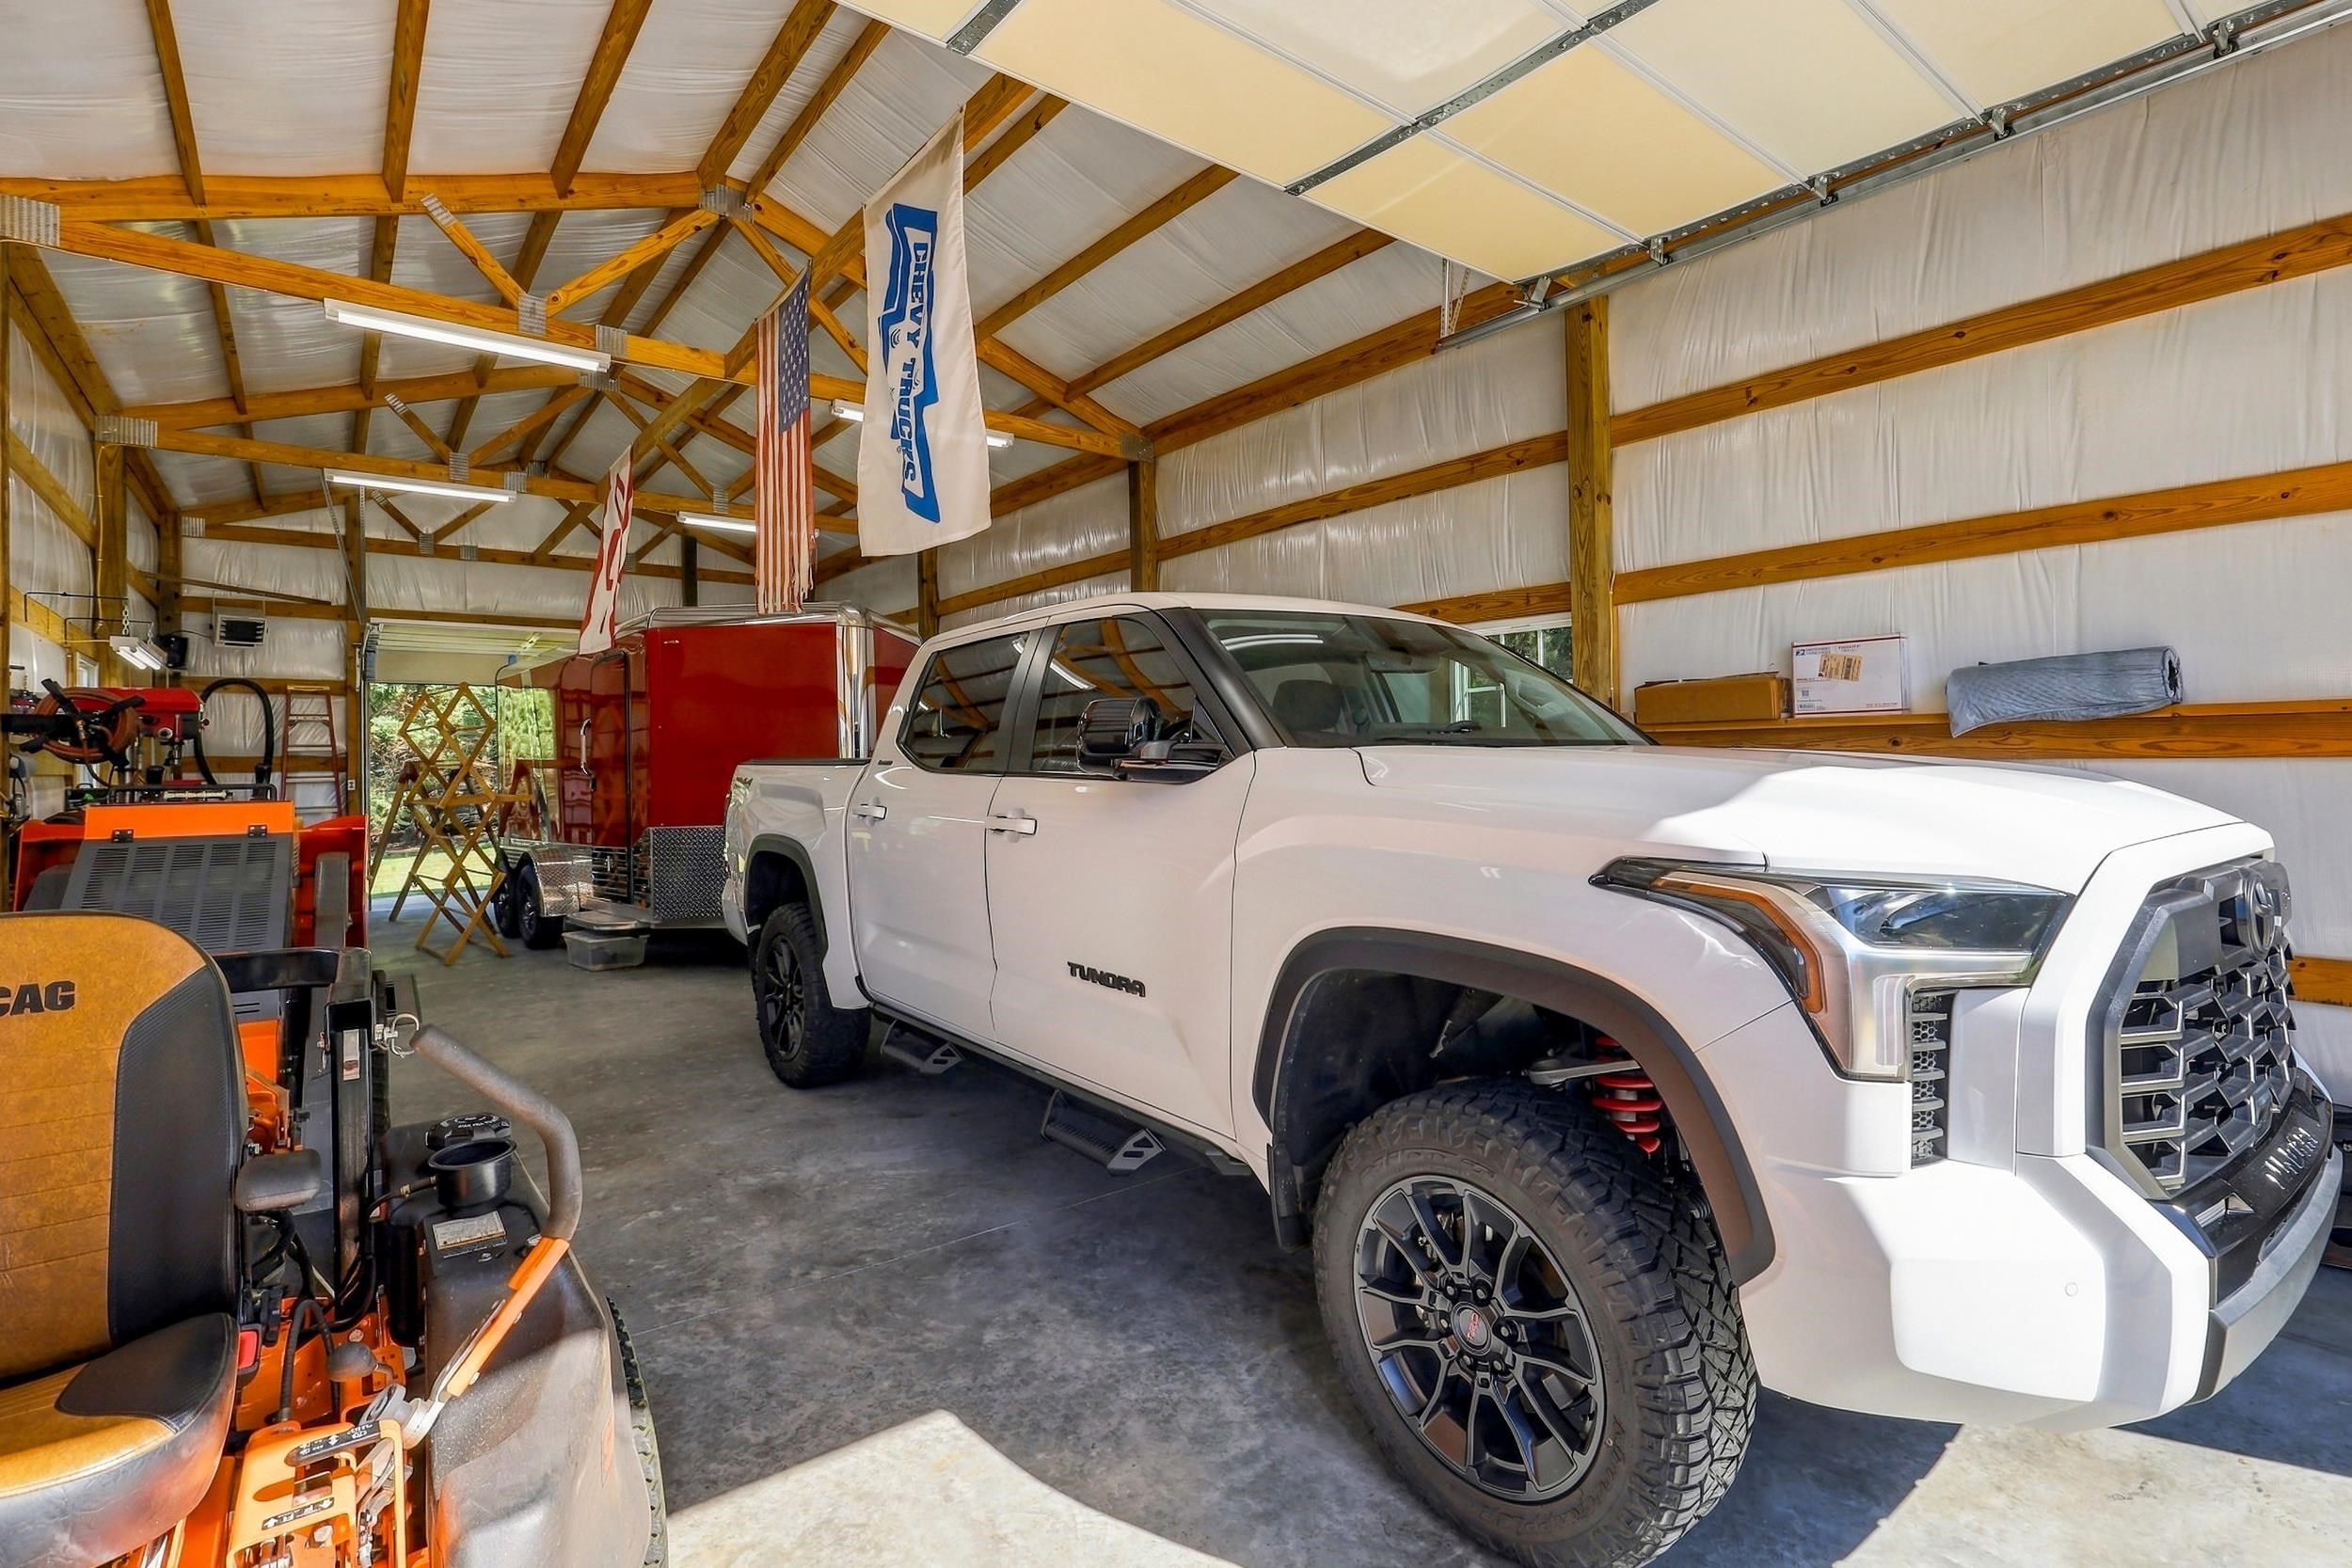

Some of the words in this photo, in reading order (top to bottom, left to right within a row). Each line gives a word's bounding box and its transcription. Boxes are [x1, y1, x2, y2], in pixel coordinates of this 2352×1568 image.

[906, 242, 929, 349] CHEVY
[898, 357, 916, 482] TRUCKS
[1067, 960, 1146, 998] TUNDRA
